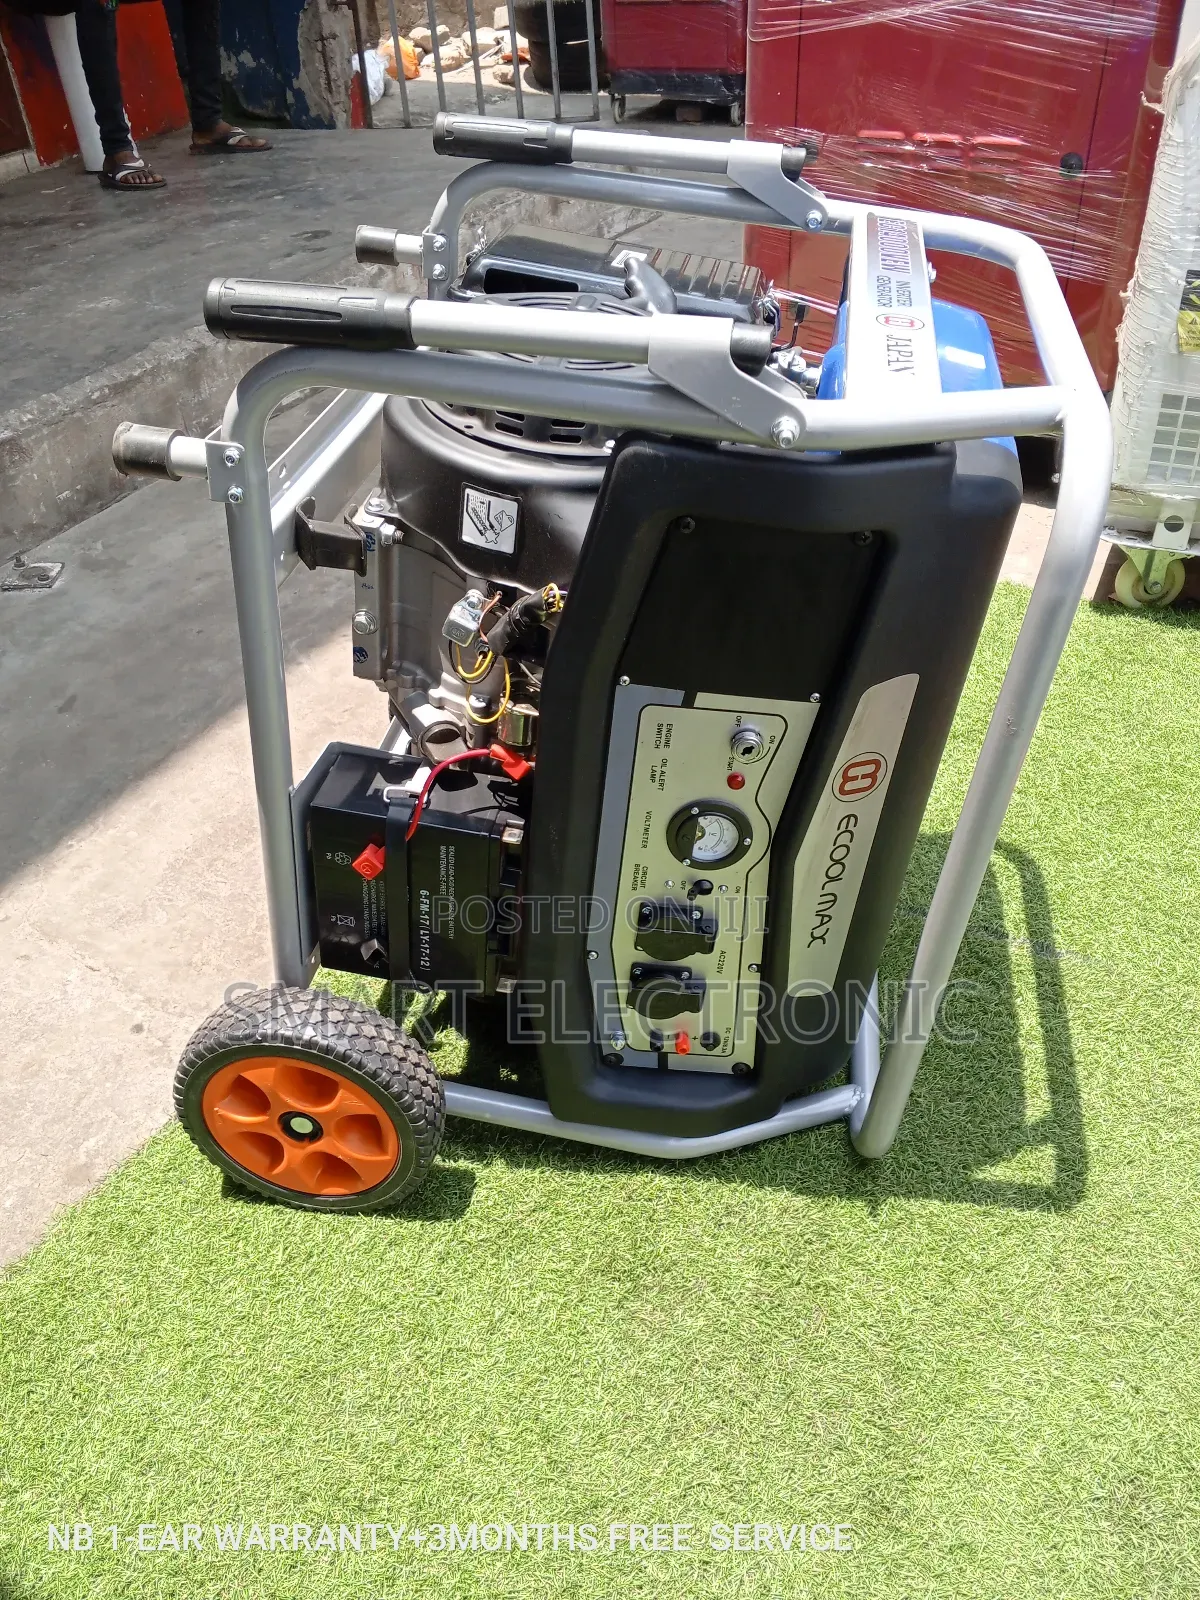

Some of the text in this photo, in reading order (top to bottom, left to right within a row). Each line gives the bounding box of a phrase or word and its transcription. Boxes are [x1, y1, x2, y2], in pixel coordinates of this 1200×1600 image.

[877, 275, 892, 308] GENERATOR
[896, 280, 912, 307] INVERTER
[886, 334, 915, 376] JAPAN
[654, 723, 664, 749] SWITCH
[663, 723, 673, 749] ENGINE
[768, 735, 776, 745] ON
[650, 765, 658, 783] LAMP
[657, 758, 668, 792] OIL ALERT
[727, 756, 735, 771] START
[641, 810, 653, 849] VOLTMETER
[439, 845, 447, 895] MAINTENANCE-FREE
[631, 863, 641, 891] BREAKER
[639, 865, 649, 889] CIRCUIT
[735, 885, 742, 894] ON
[716, 950, 727, 975] AC220V
